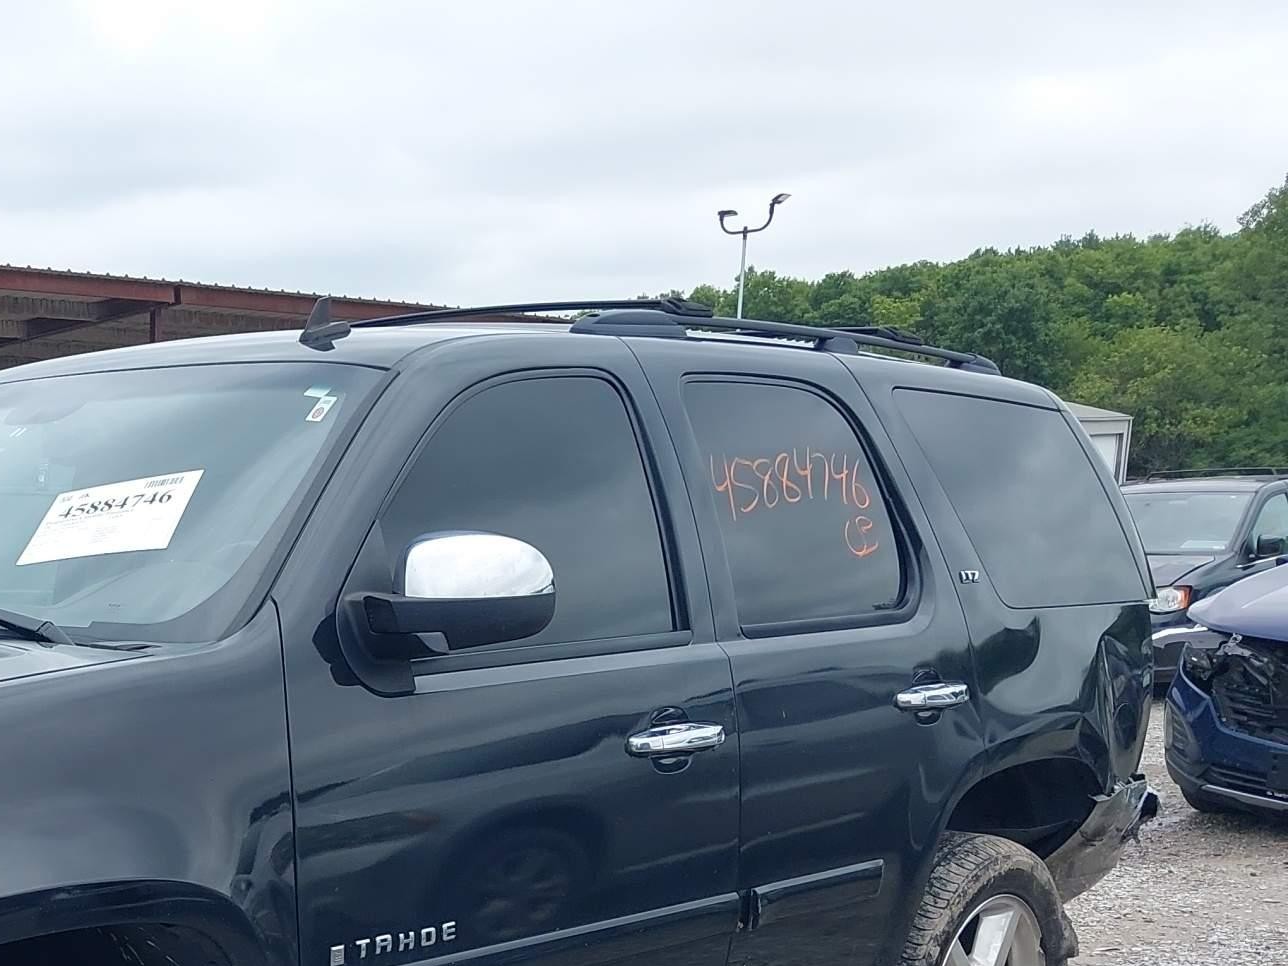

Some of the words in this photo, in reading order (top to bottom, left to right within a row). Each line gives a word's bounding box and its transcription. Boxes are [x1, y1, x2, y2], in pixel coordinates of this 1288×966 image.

[710, 447, 871, 522] 45884746
[59, 489, 176, 520] 45884746
[355, 921, 457, 959] TAHOE
